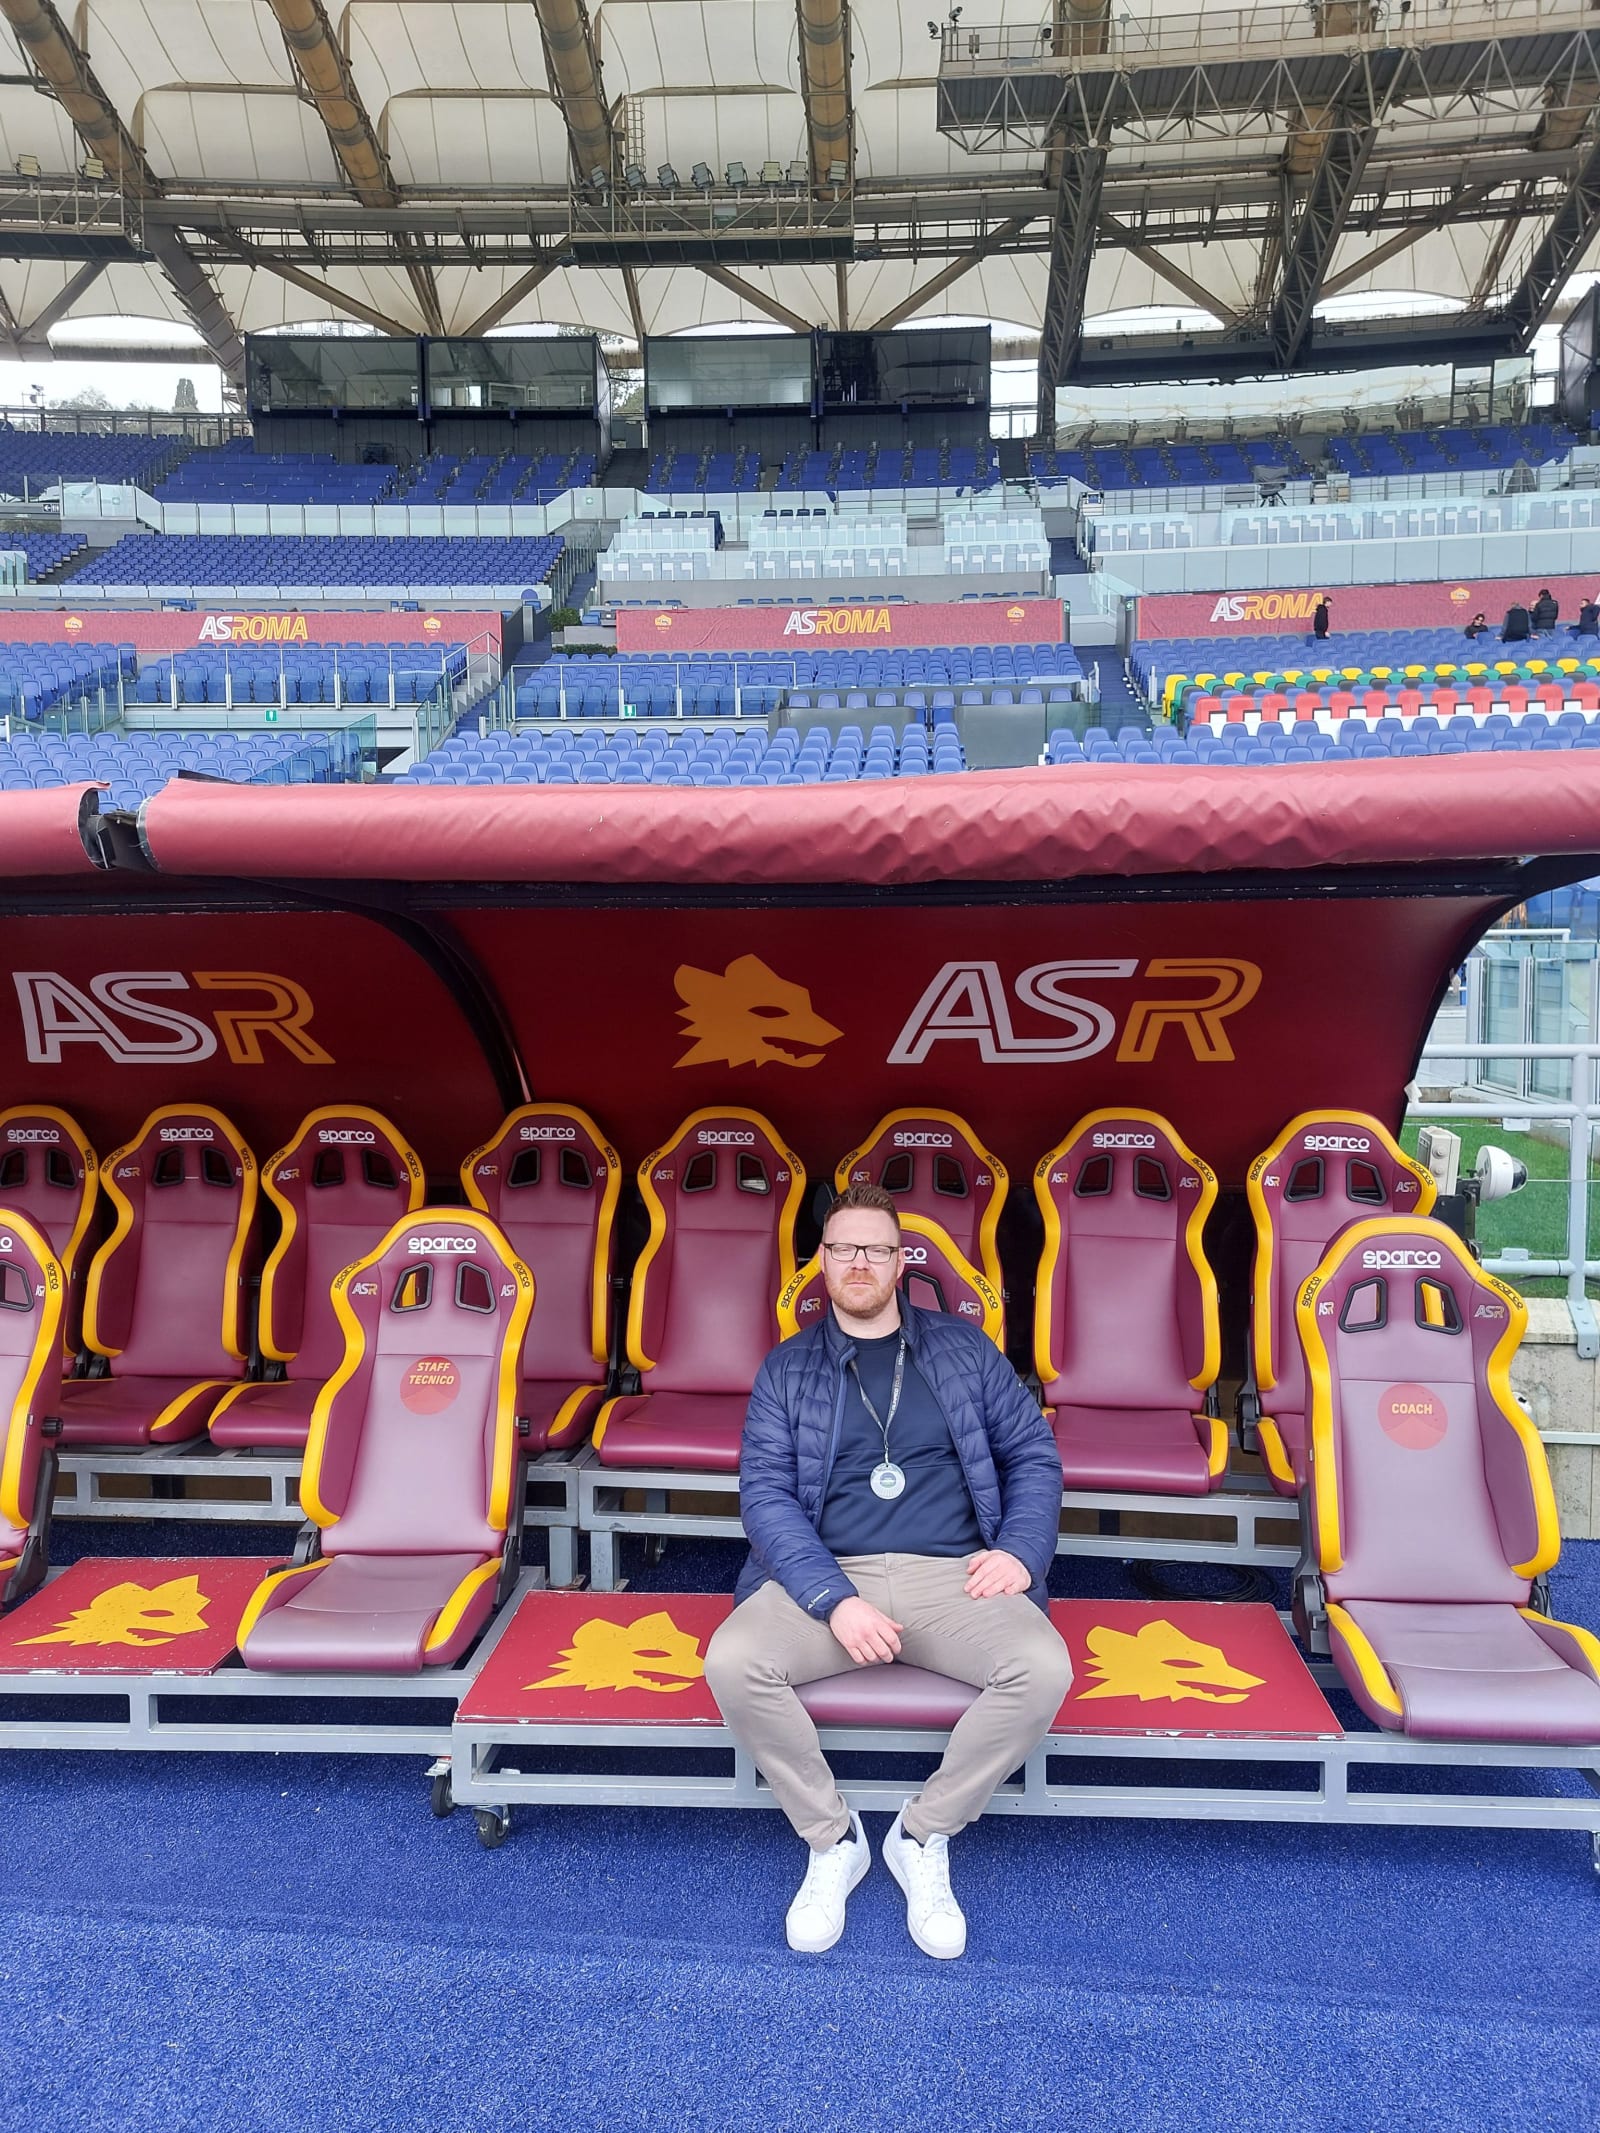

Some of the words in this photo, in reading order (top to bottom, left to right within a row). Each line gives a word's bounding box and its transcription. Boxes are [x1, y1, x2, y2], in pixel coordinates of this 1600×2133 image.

[198, 616, 308, 640] ASROMA
[783, 609, 891, 635] ASROMA
[12, 971, 336, 1064] ASR
[886, 958, 1263, 1064] ASR
[7, 1129, 60, 1142] sparco
[160, 1127, 214, 1141] sparco
[319, 1130, 375, 1144] sparco
[520, 1126, 576, 1141] sparco
[697, 1130, 755, 1145] sparco
[893, 1132, 953, 1147] sparco
[1092, 1132, 1155, 1148] sparco
[1304, 1135, 1370, 1152] sparco
[117, 1167, 140, 1178] ASR
[276, 1168, 300, 1181] ASR
[477, 1165, 498, 1175] ASR
[654, 1170, 674, 1180] ASR
[776, 1171, 790, 1182] ASR
[852, 1171, 870, 1182] ASR
[976, 1175, 992, 1186] ASR
[1051, 1172, 1068, 1183] ASR
[1179, 1177, 1199, 1188] ASR
[1263, 1175, 1281, 1187] ASR
[1395, 1181, 1417, 1193] ASR
[408, 1236, 477, 1254] sparco
[1362, 1250, 1441, 1269] sparco
[351, 1282, 378, 1295] ASR
[501, 1284, 516, 1297] ASR
[781, 1273, 806, 1309] sparco
[972, 1275, 999, 1311] sparco
[1302, 1276, 1322, 1308] sparco
[1488, 1278, 1524, 1310] sparco
[800, 1297, 821, 1313] ASR
[958, 1300, 981, 1316] ASR
[1318, 1301, 1334, 1316] ASR
[1474, 1304, 1505, 1318] ASR
[416, 1362, 451, 1372] STAFF
[409, 1374, 455, 1385] TECNICO
[1391, 1403, 1433, 1415] COACH
